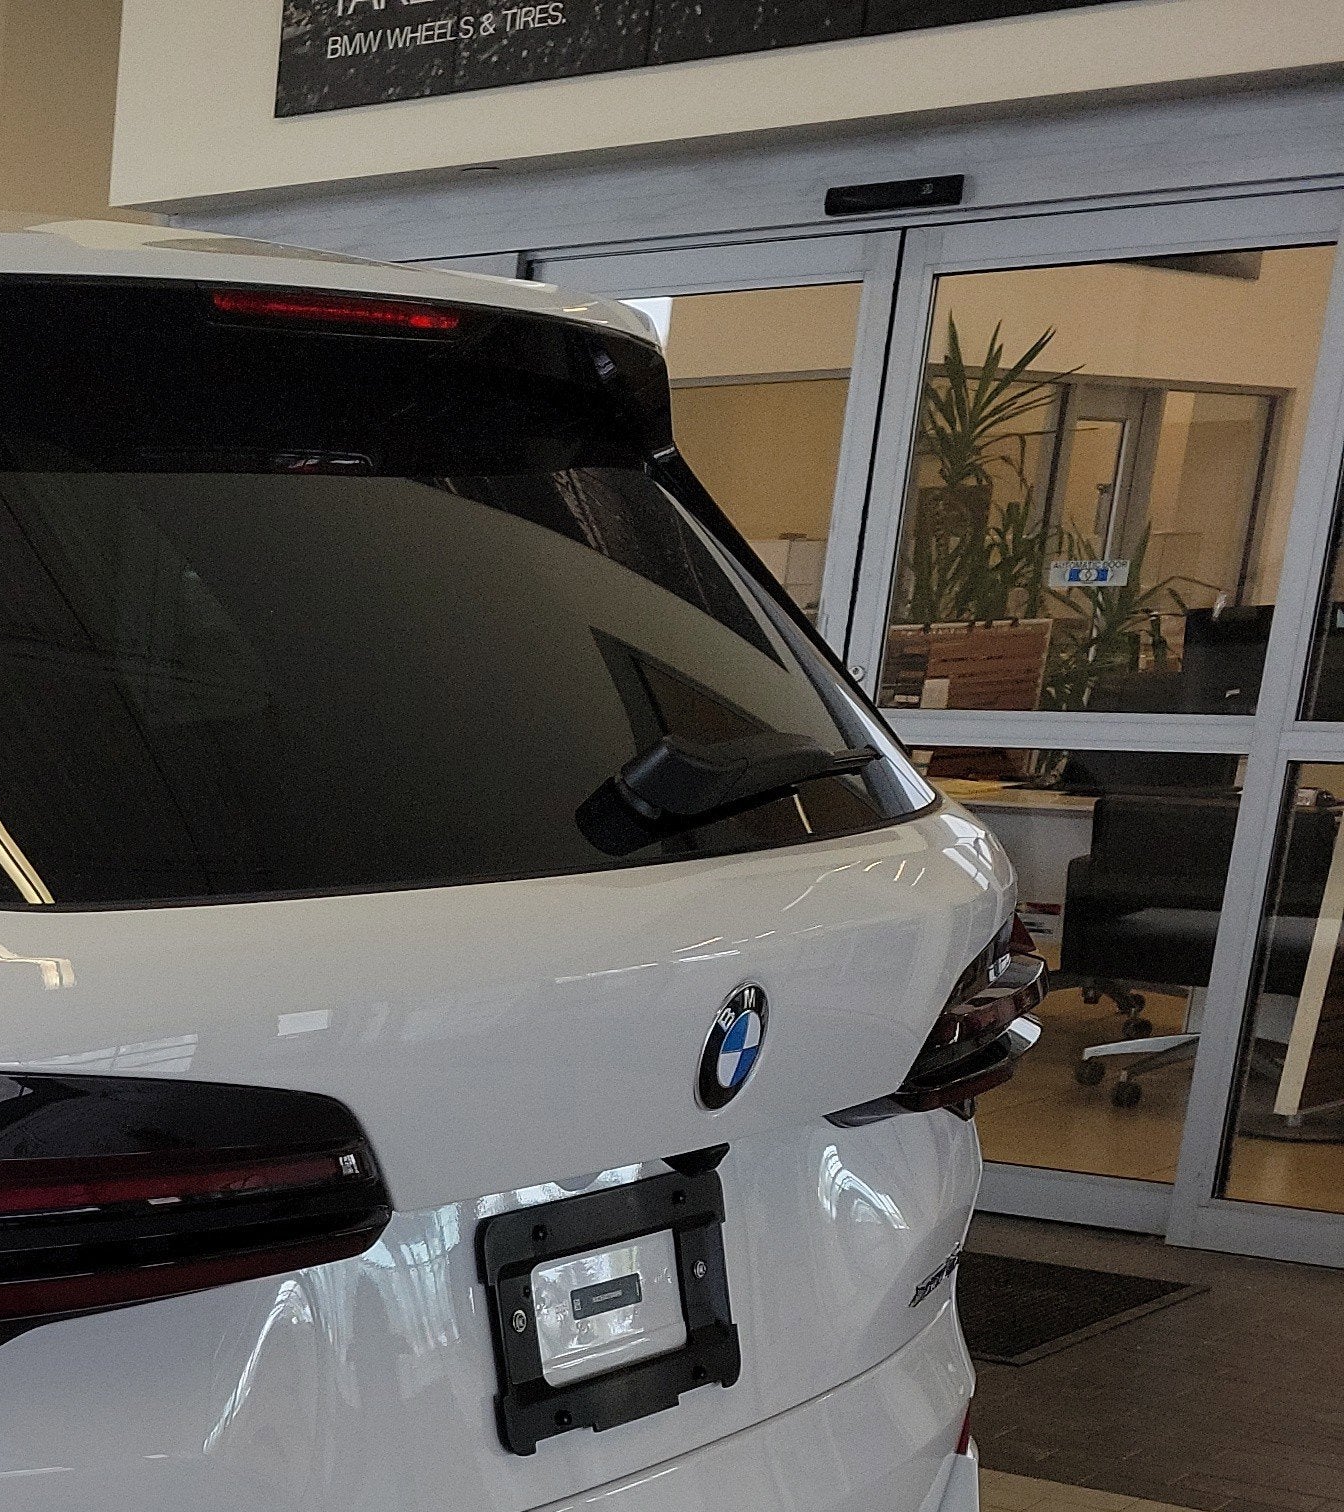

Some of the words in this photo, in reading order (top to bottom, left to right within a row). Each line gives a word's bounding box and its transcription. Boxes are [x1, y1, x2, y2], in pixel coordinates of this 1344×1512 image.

[326, 29, 383, 59] BMW
[387, 16, 474, 49] WHEELS
[478, 11, 497, 36] &
[502, 2, 567, 32] TIRES.
